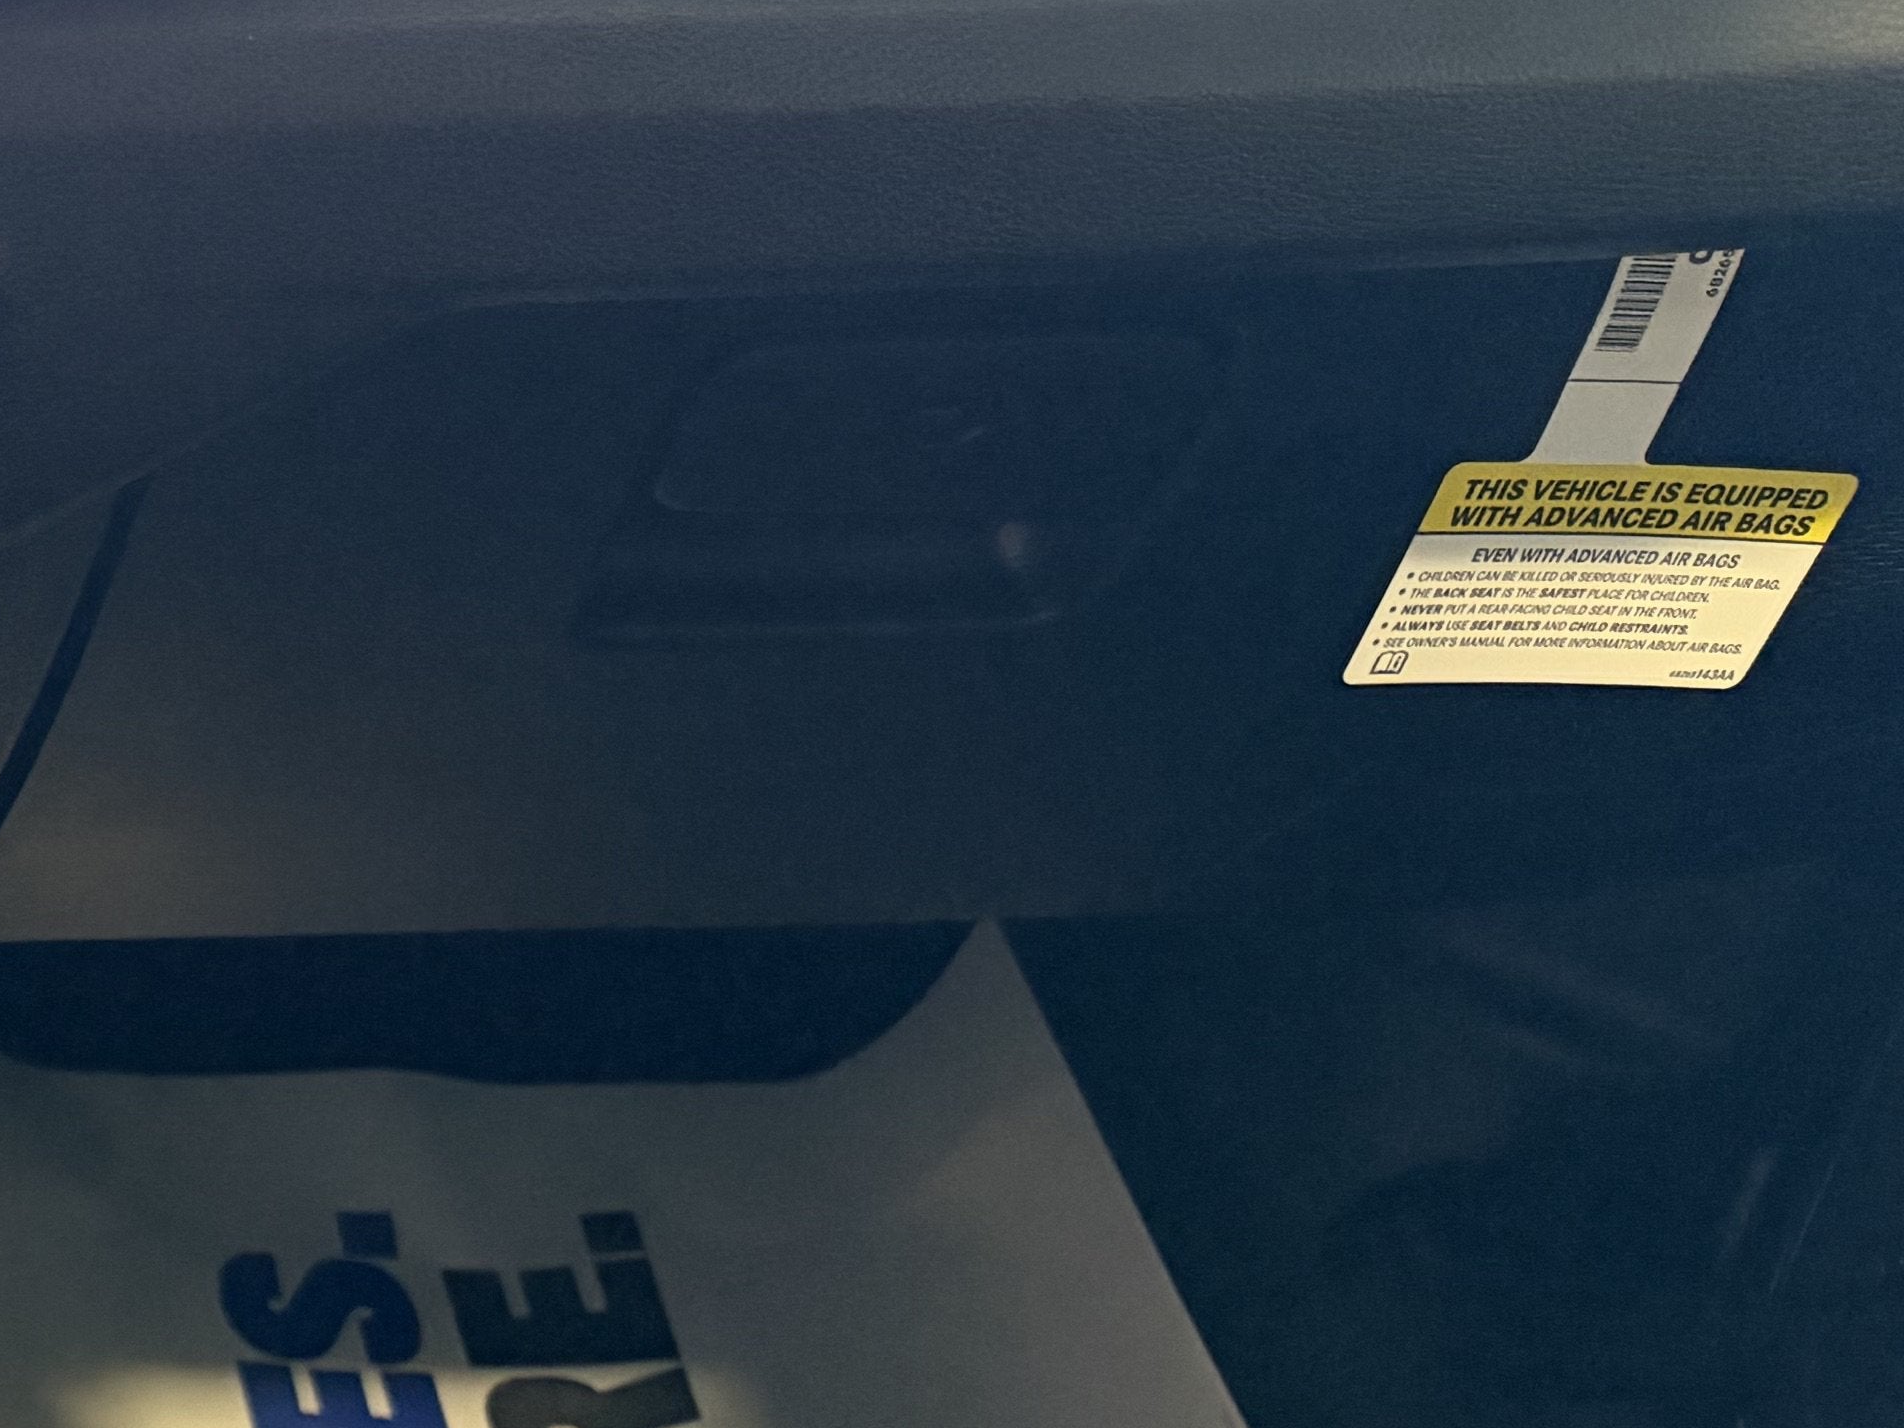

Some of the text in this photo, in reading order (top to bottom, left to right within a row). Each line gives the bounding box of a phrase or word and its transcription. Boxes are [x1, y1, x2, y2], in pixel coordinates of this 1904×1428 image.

[1464, 478, 1829, 511] THIS VEHICLE IS EQUIPPED
[1450, 505, 1816, 538] WITH ADVANCED AIR BAGS
[1471, 548, 1741, 569] EVEN WITH ADVANCED AIR BAGS
[1418, 571, 1754, 590] CHILDREN CAN BE KILLED OR SERIOUSLY INJURED BY THE AIR
[1410, 588, 1649, 601] THE BACK SEAT IS THE SAFEST PLACE FOR
[1400, 604, 1657, 618] NEVER PUT CHILD SEAT IN THE
[1391, 621, 1608, 633] ALWAYS USE SEAT BELTS AND CHILD
[1382, 638, 1709, 653] SEE MANUAL FOR MORE INFORMATION ABOUT AIR
